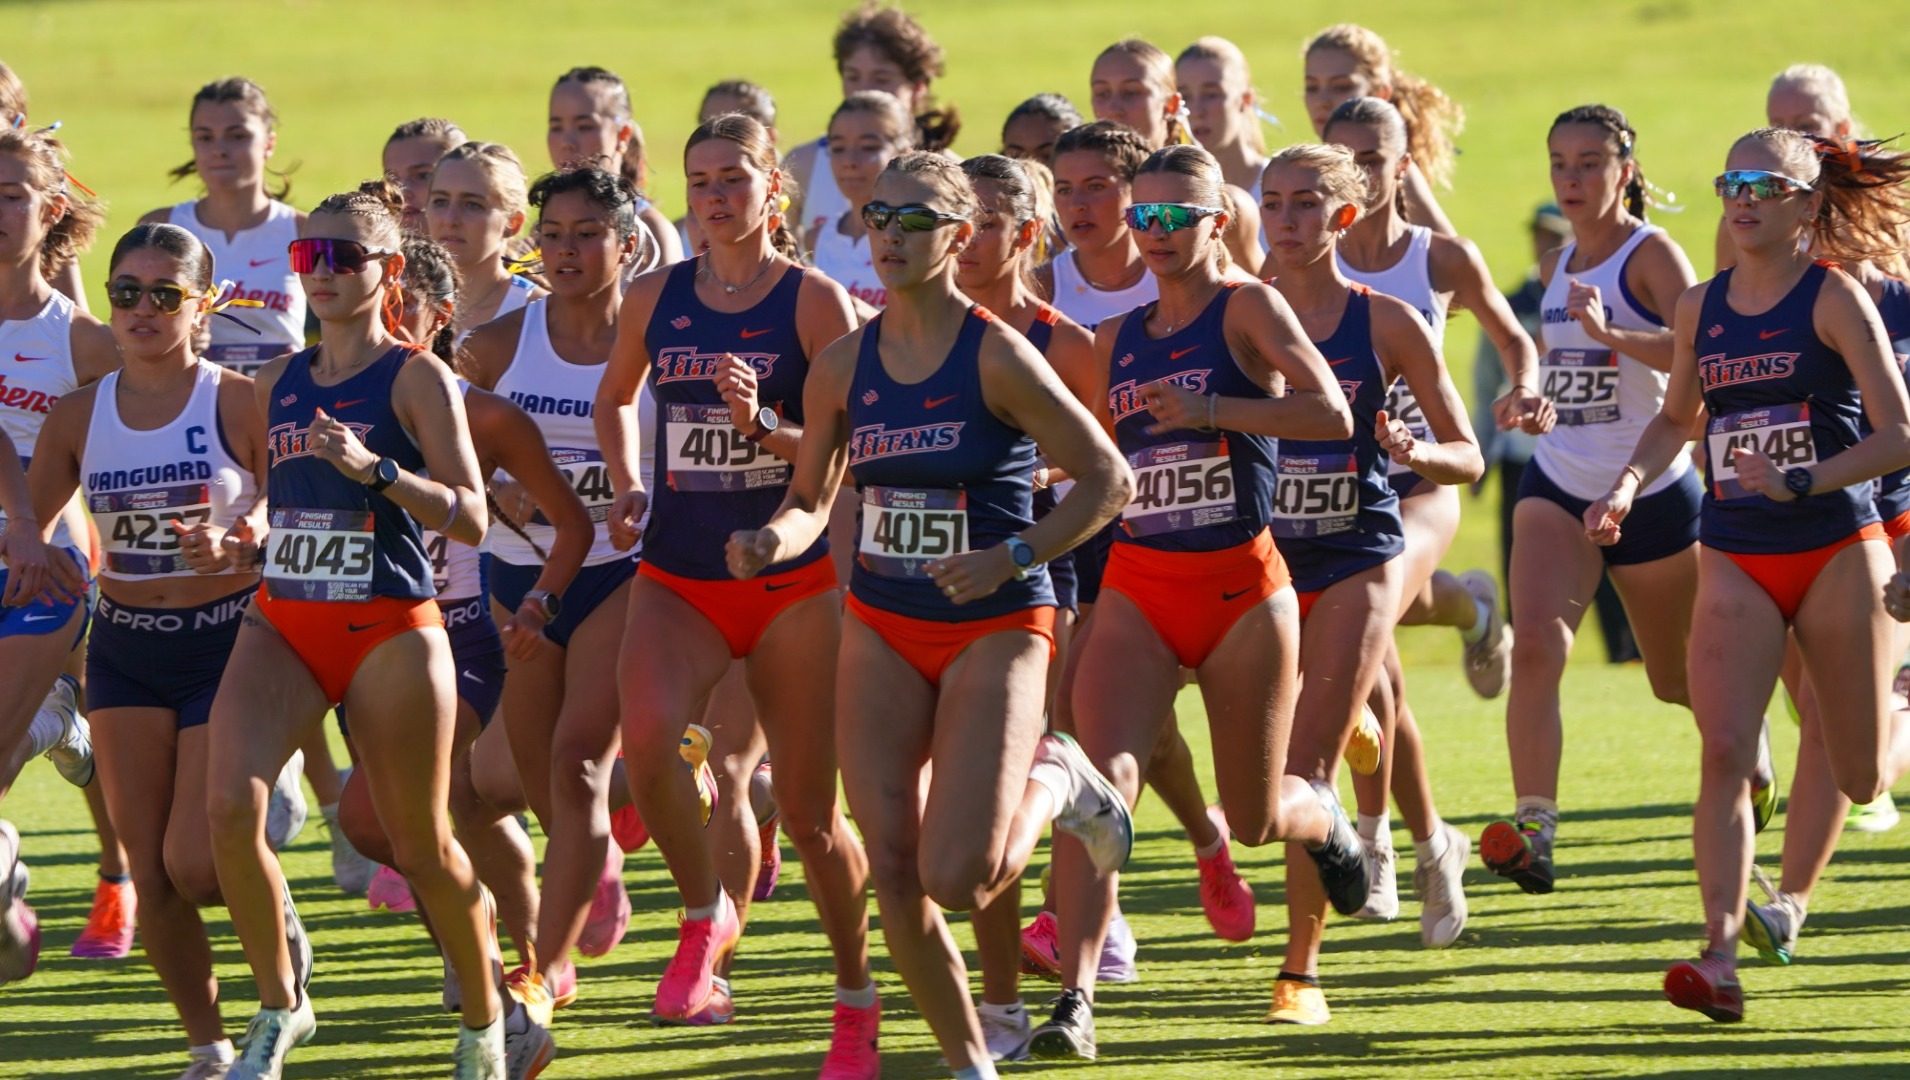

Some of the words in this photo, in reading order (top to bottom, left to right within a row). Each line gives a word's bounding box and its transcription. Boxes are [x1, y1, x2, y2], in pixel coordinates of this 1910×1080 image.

[1543, 370, 1618, 404] 4235
[706, 407, 732, 415] FINISH
[185, 425, 208, 454] C
[88, 461, 212, 492] VANGUARD
[1131, 461, 1232, 511] 4056
[873, 511, 964, 554] 4051
[274, 533, 374, 576] 4043
[112, 608, 184, 631] PRO
[193, 590, 257, 631] NIK
